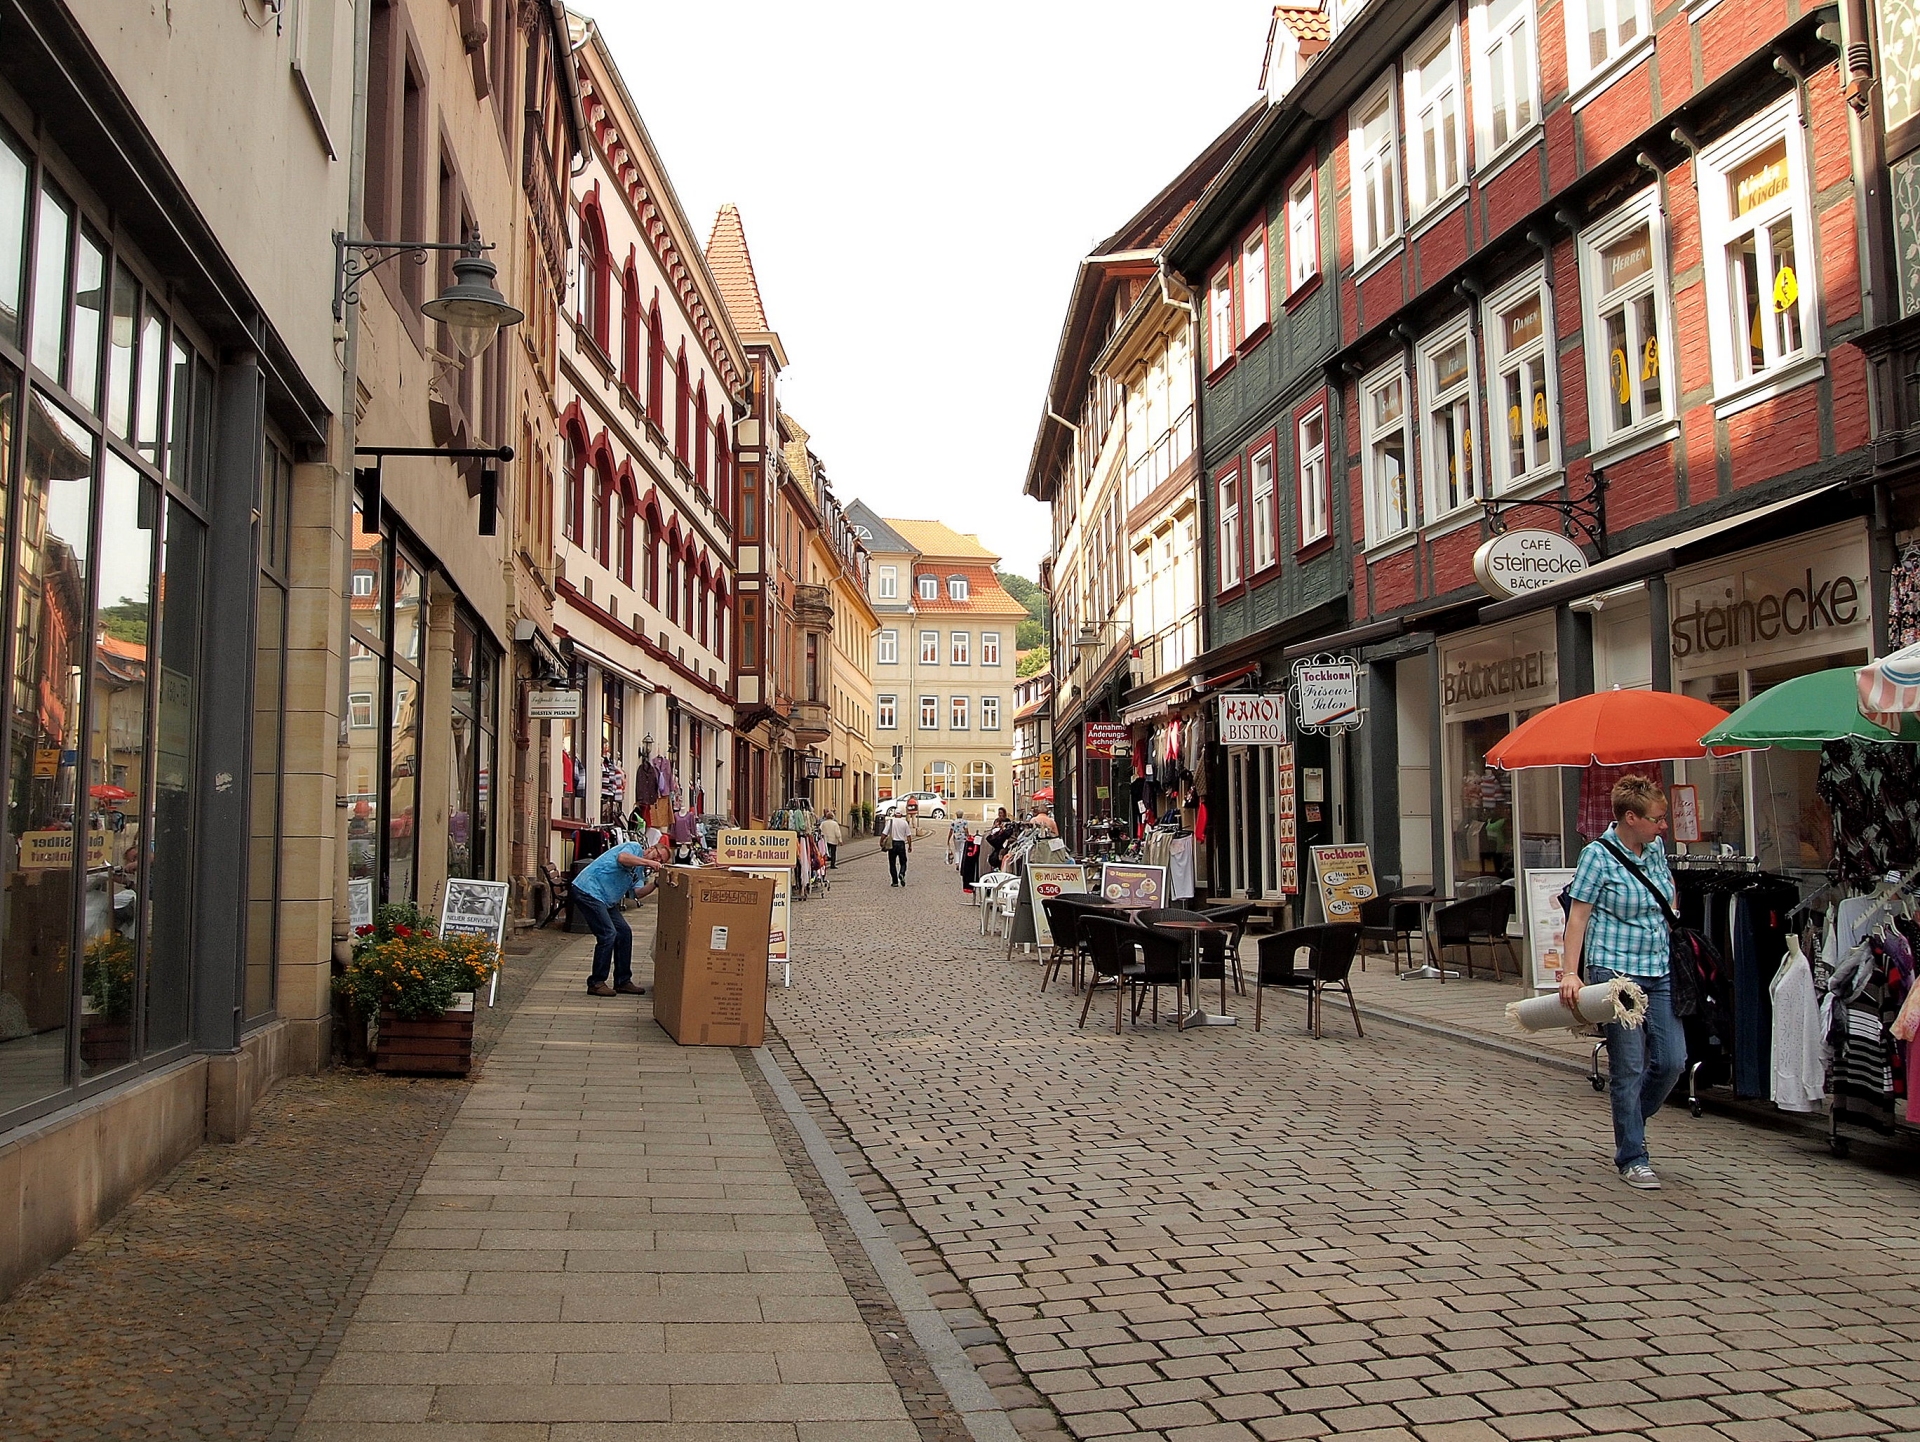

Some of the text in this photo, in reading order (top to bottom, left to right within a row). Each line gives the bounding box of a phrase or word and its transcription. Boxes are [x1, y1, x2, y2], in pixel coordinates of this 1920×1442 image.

[1521, 538, 1551, 550] CAFÉ
[1493, 552, 1582, 573] steinecke
[1510, 576, 1555, 589] BÄCKE
[1671, 567, 1859, 659] steinecke
[1444, 650, 1545, 706] BÄCKEREI
[1303, 684, 1353, 698] Friseur-
[1226, 699, 1279, 722] HANOI
[1312, 698, 1347, 711] Salon
[1088, 730, 1128, 739] Änderungs-
[1229, 724, 1278, 740] BISTRO
[725, 835, 790, 847] Gold & Silber
[737, 849, 789, 860] Bar-Ankauf
[1038, 886, 1060, 894] 3.50€
[467, 916, 492, 924] SERVICE!
